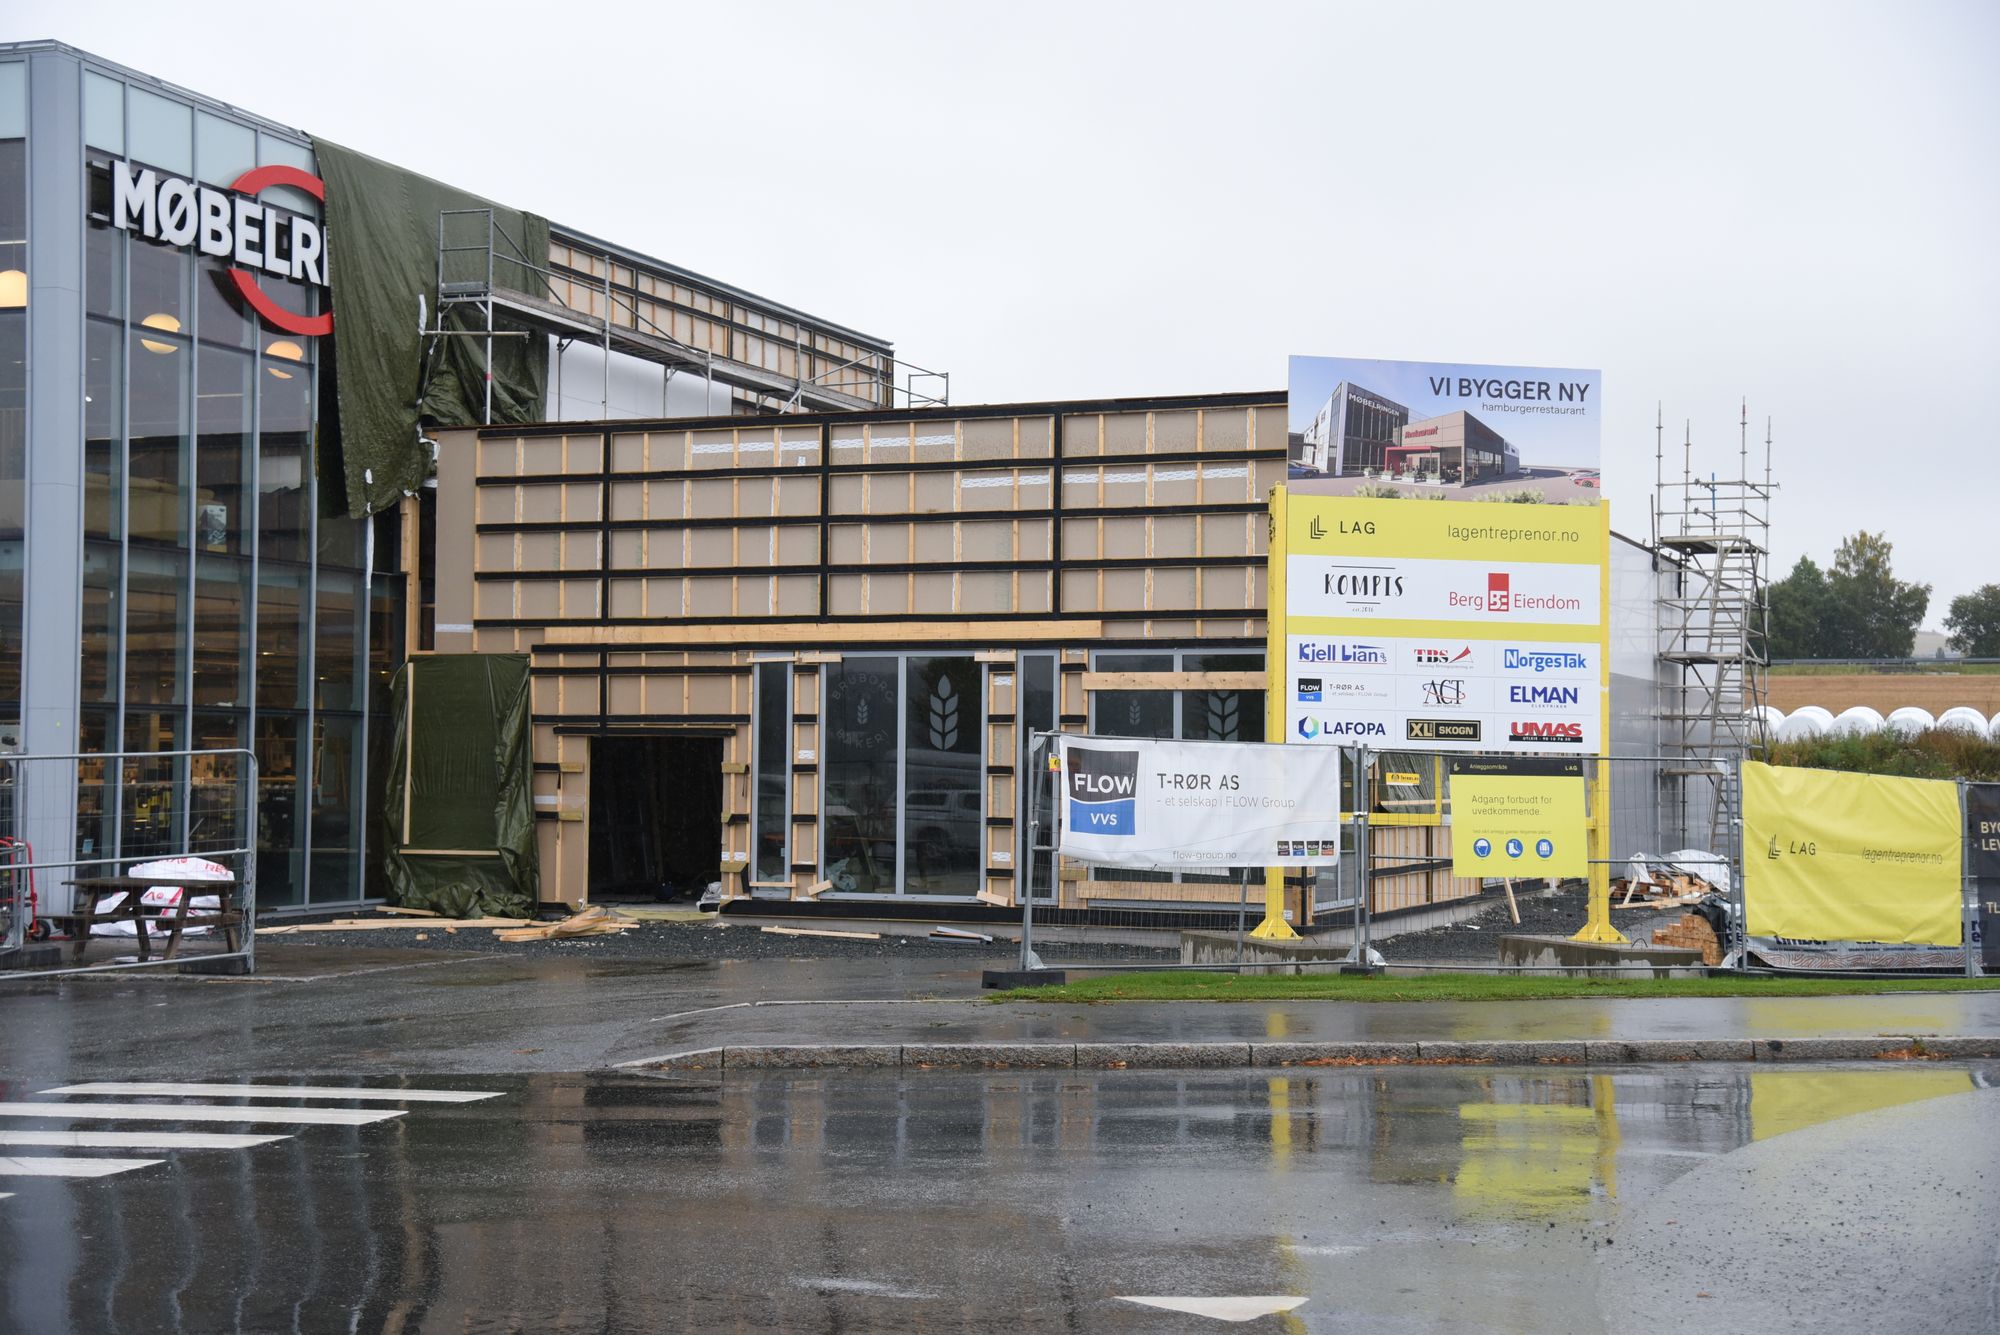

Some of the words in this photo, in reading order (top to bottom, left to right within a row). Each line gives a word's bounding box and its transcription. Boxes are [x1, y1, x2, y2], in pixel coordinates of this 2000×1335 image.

[1429, 377, 1450, 396] VI
[1458, 378, 1551, 400] BYGGER
[1559, 383, 1590, 402] NY
[1348, 392, 1400, 417] MØBELRINGEN
[1482, 402, 1585, 415] hamburgerrestaurant
[1340, 521, 1376, 535] LAG
[1448, 524, 1579, 542] lagentreprenor.no
[1324, 573, 1404, 597] KOMPIS
[1449, 591, 1483, 610] Berg
[1514, 593, 1580, 610] Eiendom
[1299, 643, 1336, 662] Kjell
[1341, 644, 1378, 662] Lian
[1414, 649, 1448, 663] TBS
[1422, 679, 1464, 704] ACT
[1510, 685, 1578, 704] ELMAN
[1324, 722, 1386, 736] LAFOPA
[1410, 722, 1433, 737] XL
[1439, 726, 1473, 735] SKOGN
[1511, 722, 1582, 737] UMAS
[1074, 773, 1134, 794] FLOW
[1157, 773, 1211, 790] T-RØR
[1219, 774, 1240, 790] AS
[1165, 797, 1175, 806] et
[1178, 796, 1217, 808] selskap
[1225, 797, 1259, 808] FLOW
[1262, 798, 1295, 809] Group
[1472, 795, 1505, 805] Adgang
[1507, 795, 1538, 804] forbudt
[1540, 796, 1552, 804] for
[1090, 813, 1117, 825] VVS
[1790, 840, 1816, 855] LAG
[1173, 851, 1237, 861] flow-group.no
[1862, 847, 1943, 865] lagentreprenor.no
